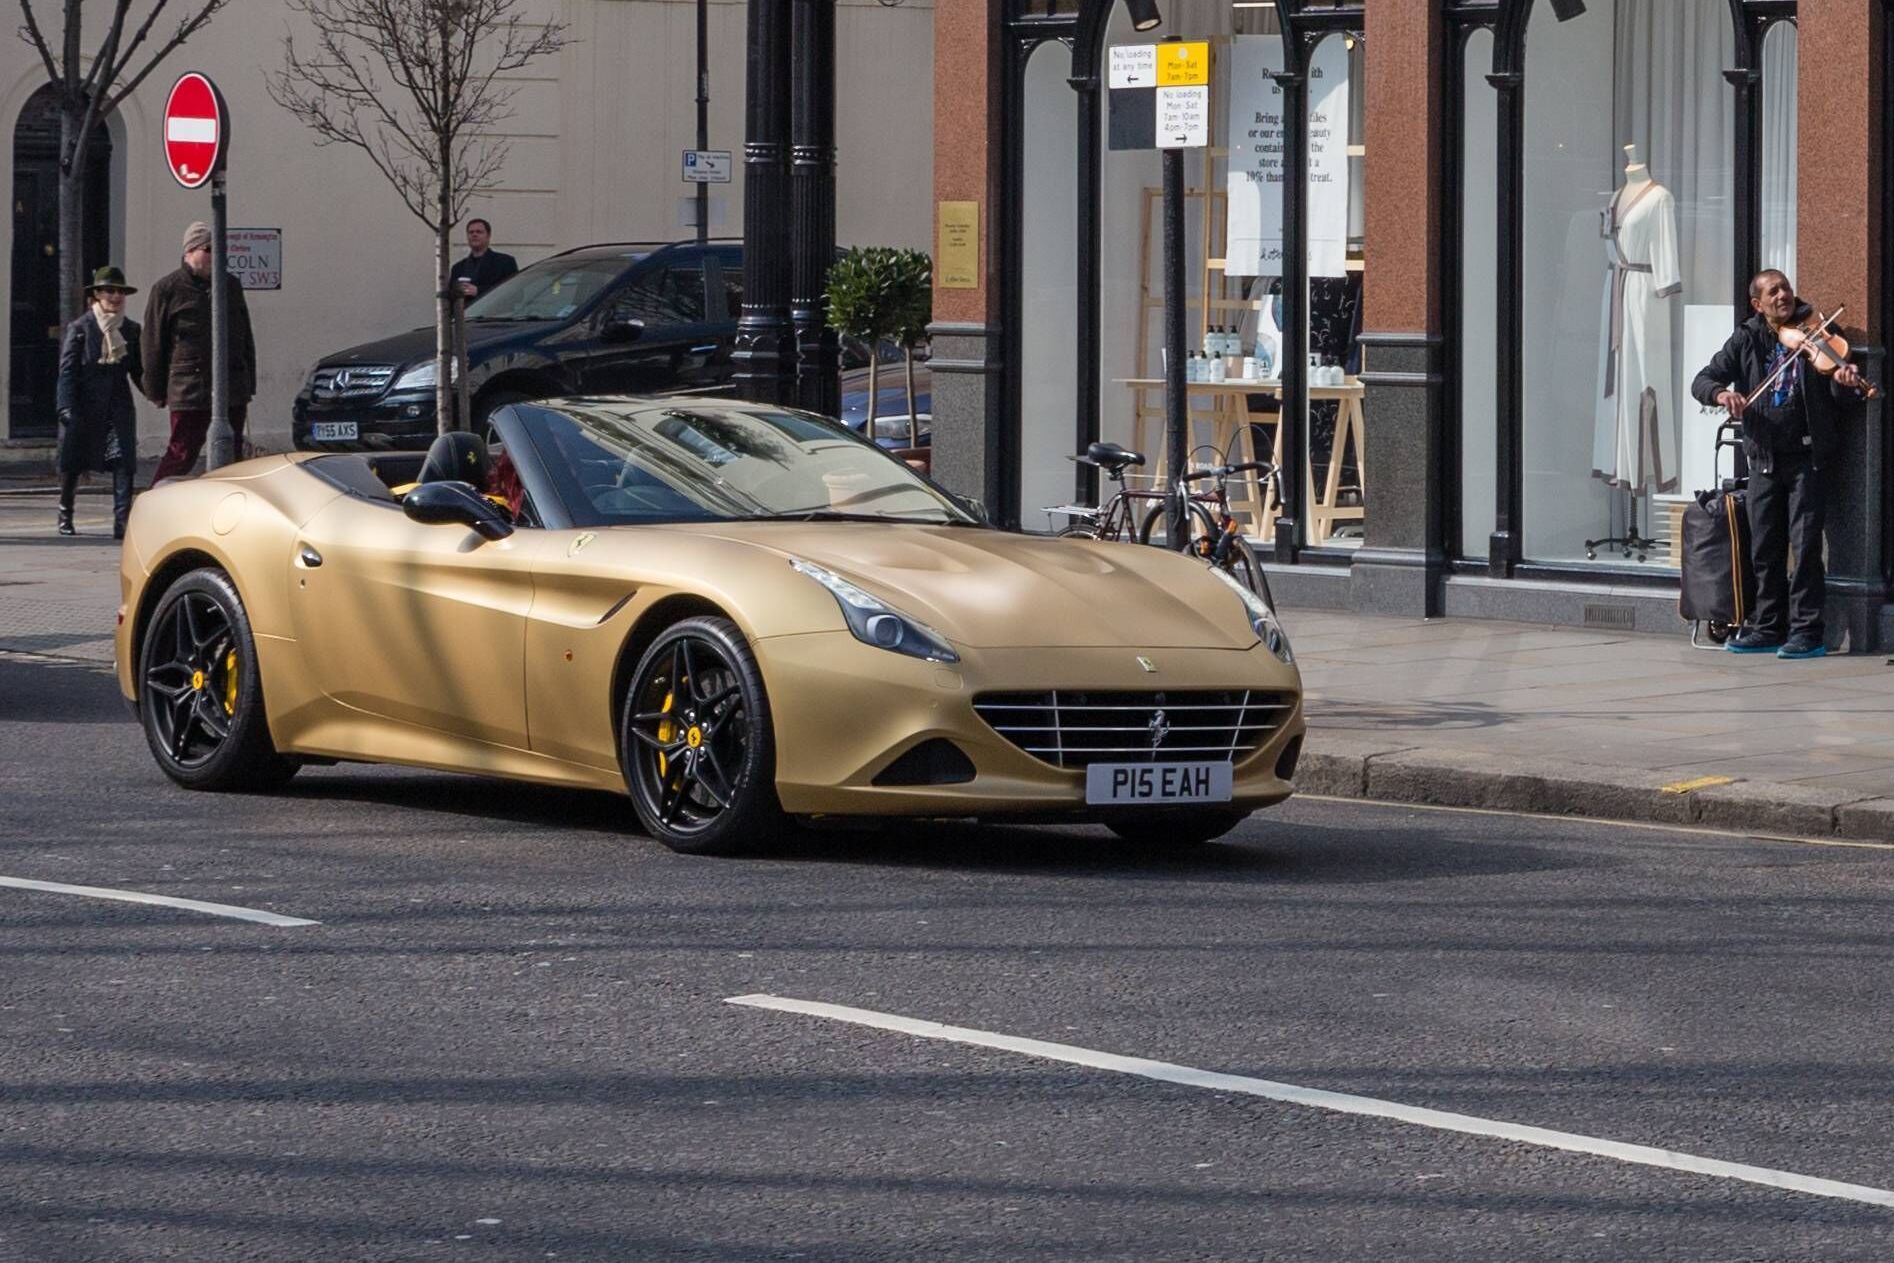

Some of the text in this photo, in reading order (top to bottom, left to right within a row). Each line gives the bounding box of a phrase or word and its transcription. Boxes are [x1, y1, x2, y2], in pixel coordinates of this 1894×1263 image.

[1113, 49, 1152, 59] No loading
[1113, 61, 1152, 72] at any time
[1163, 90, 1202, 99] No loading
[1254, 112, 1280, 126] Bring
[1248, 128, 1259, 138] or
[1260, 128, 1275, 138] our
[1311, 144, 1325, 153] the
[1259, 157, 1279, 168] store
[1160, 766, 1211, 798] EAH
